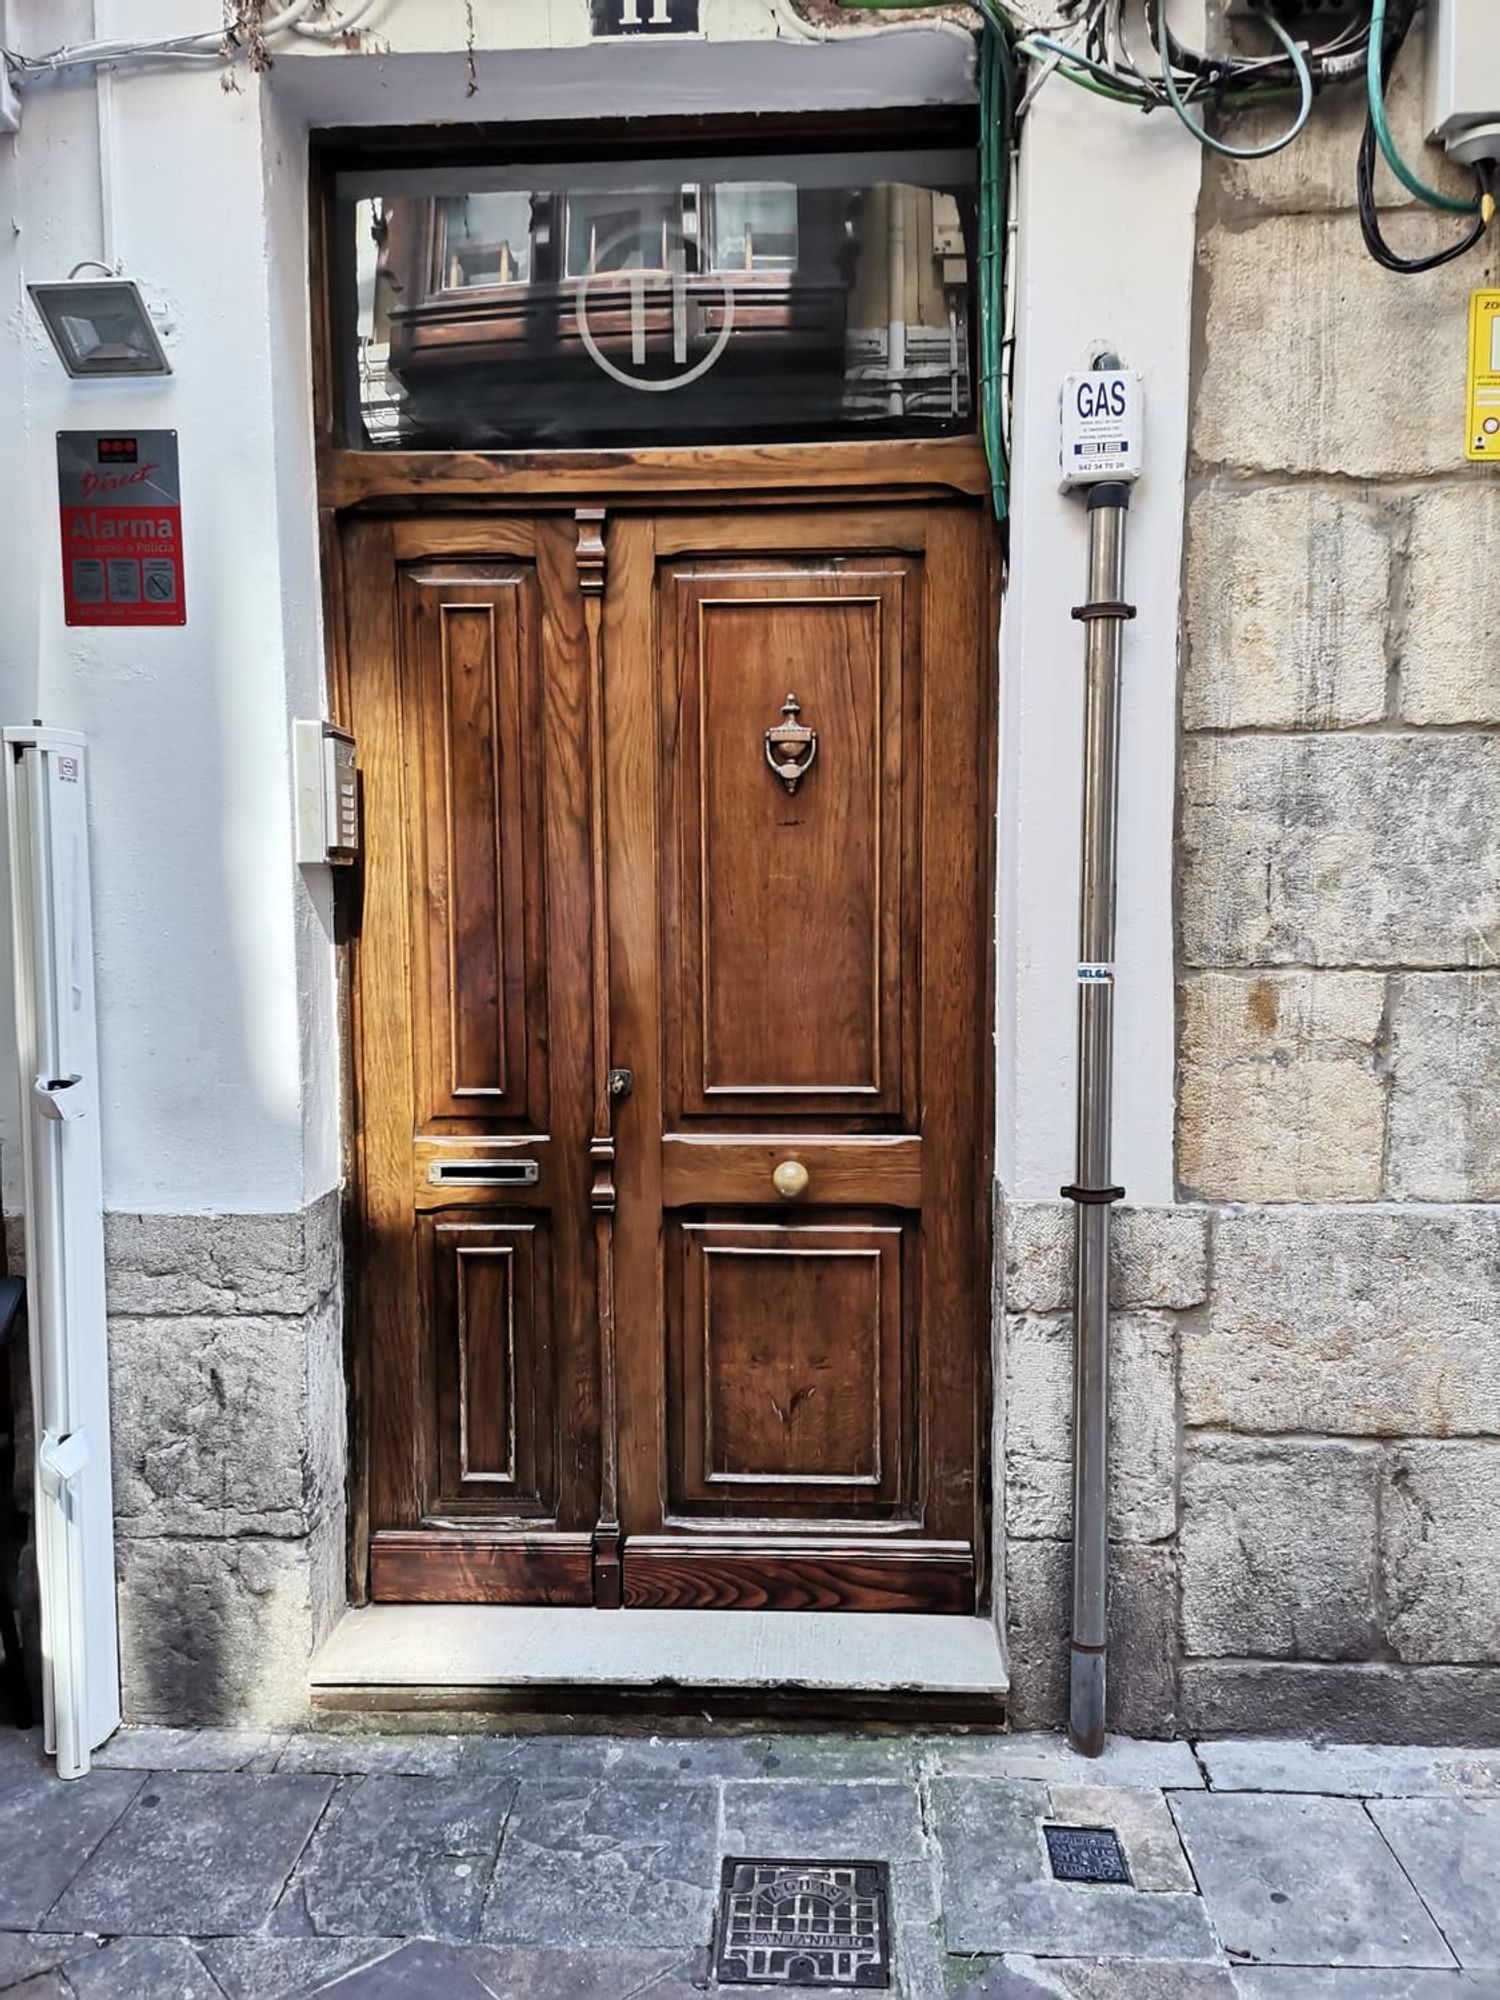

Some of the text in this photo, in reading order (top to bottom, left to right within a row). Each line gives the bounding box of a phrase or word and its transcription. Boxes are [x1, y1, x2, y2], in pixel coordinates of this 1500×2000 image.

[1077, 380, 1126, 418] GAS
[82, 463, 160, 499] Direct
[71, 511, 174, 539] Alarma
[767, 1877, 843, 1900] AGUAS
[745, 1931, 865, 1948] SANTANDER
